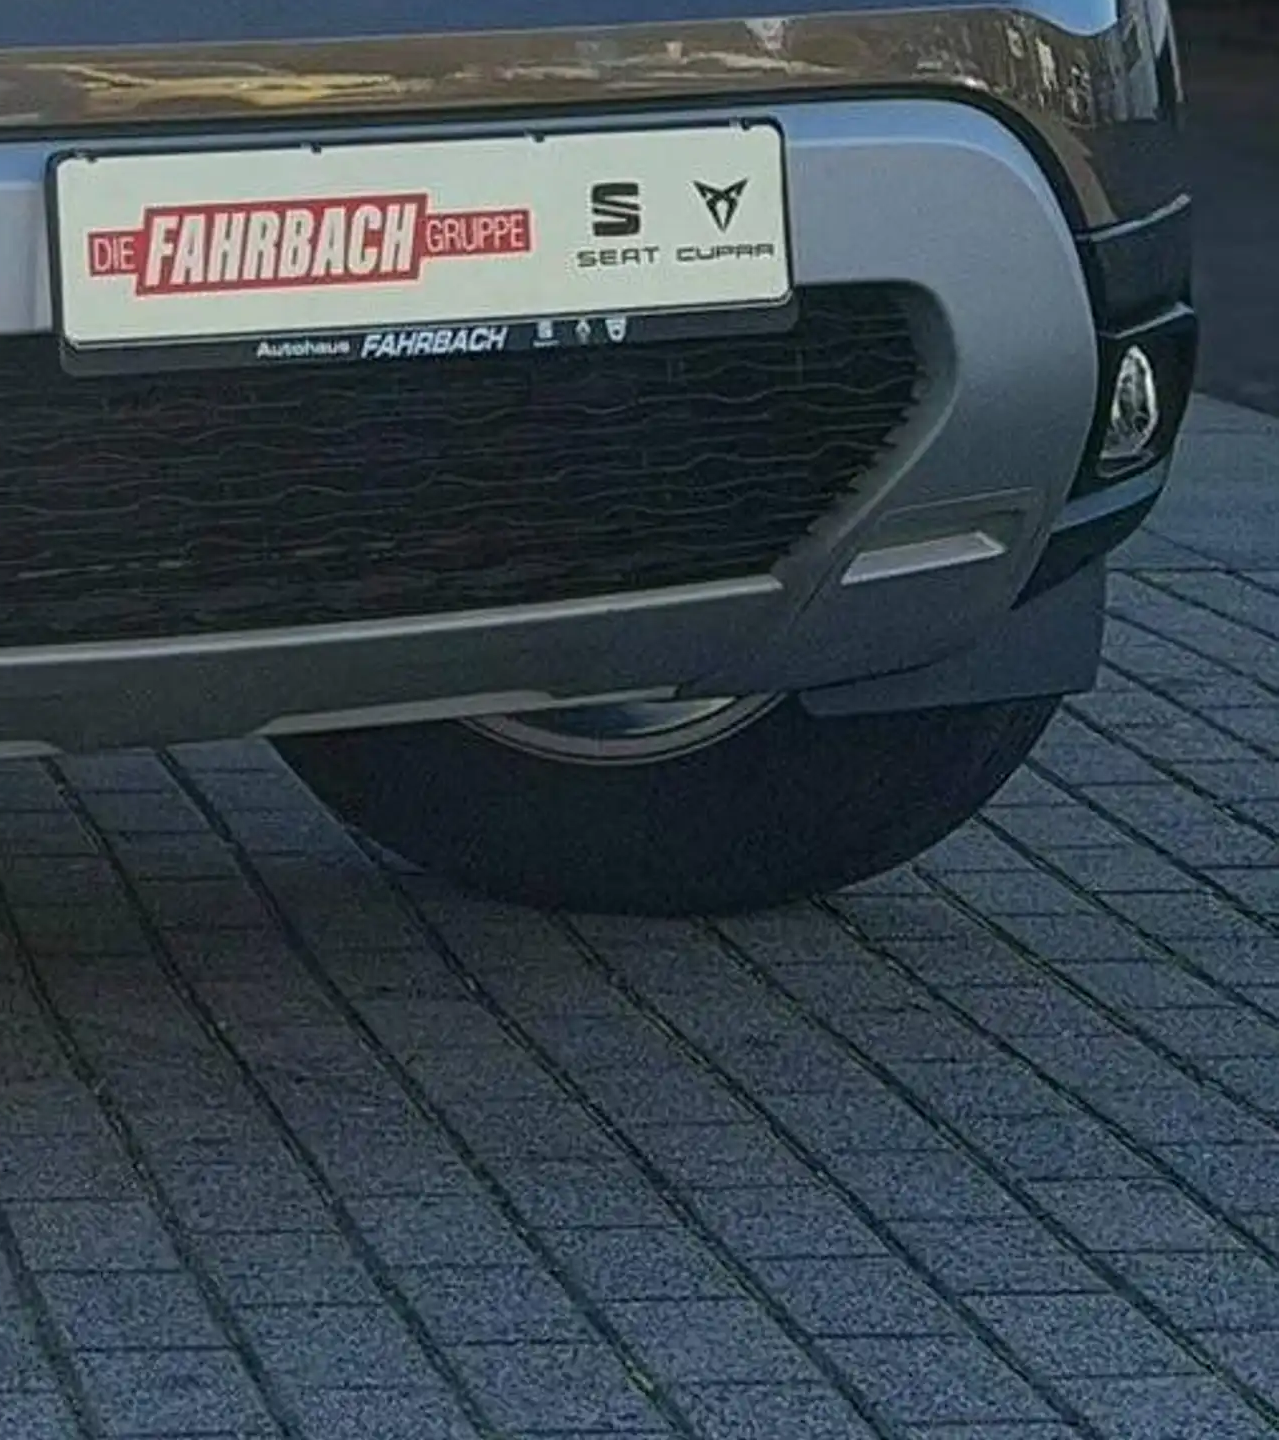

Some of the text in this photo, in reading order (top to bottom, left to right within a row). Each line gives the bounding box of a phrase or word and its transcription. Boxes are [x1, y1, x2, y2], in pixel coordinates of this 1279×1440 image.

[93, 203, 525, 287] DIE FAHRBACH GRUPPE
[576, 242, 776, 268] SEAT CUPRA
[256, 327, 509, 360] Autohaus FAHRBACH
